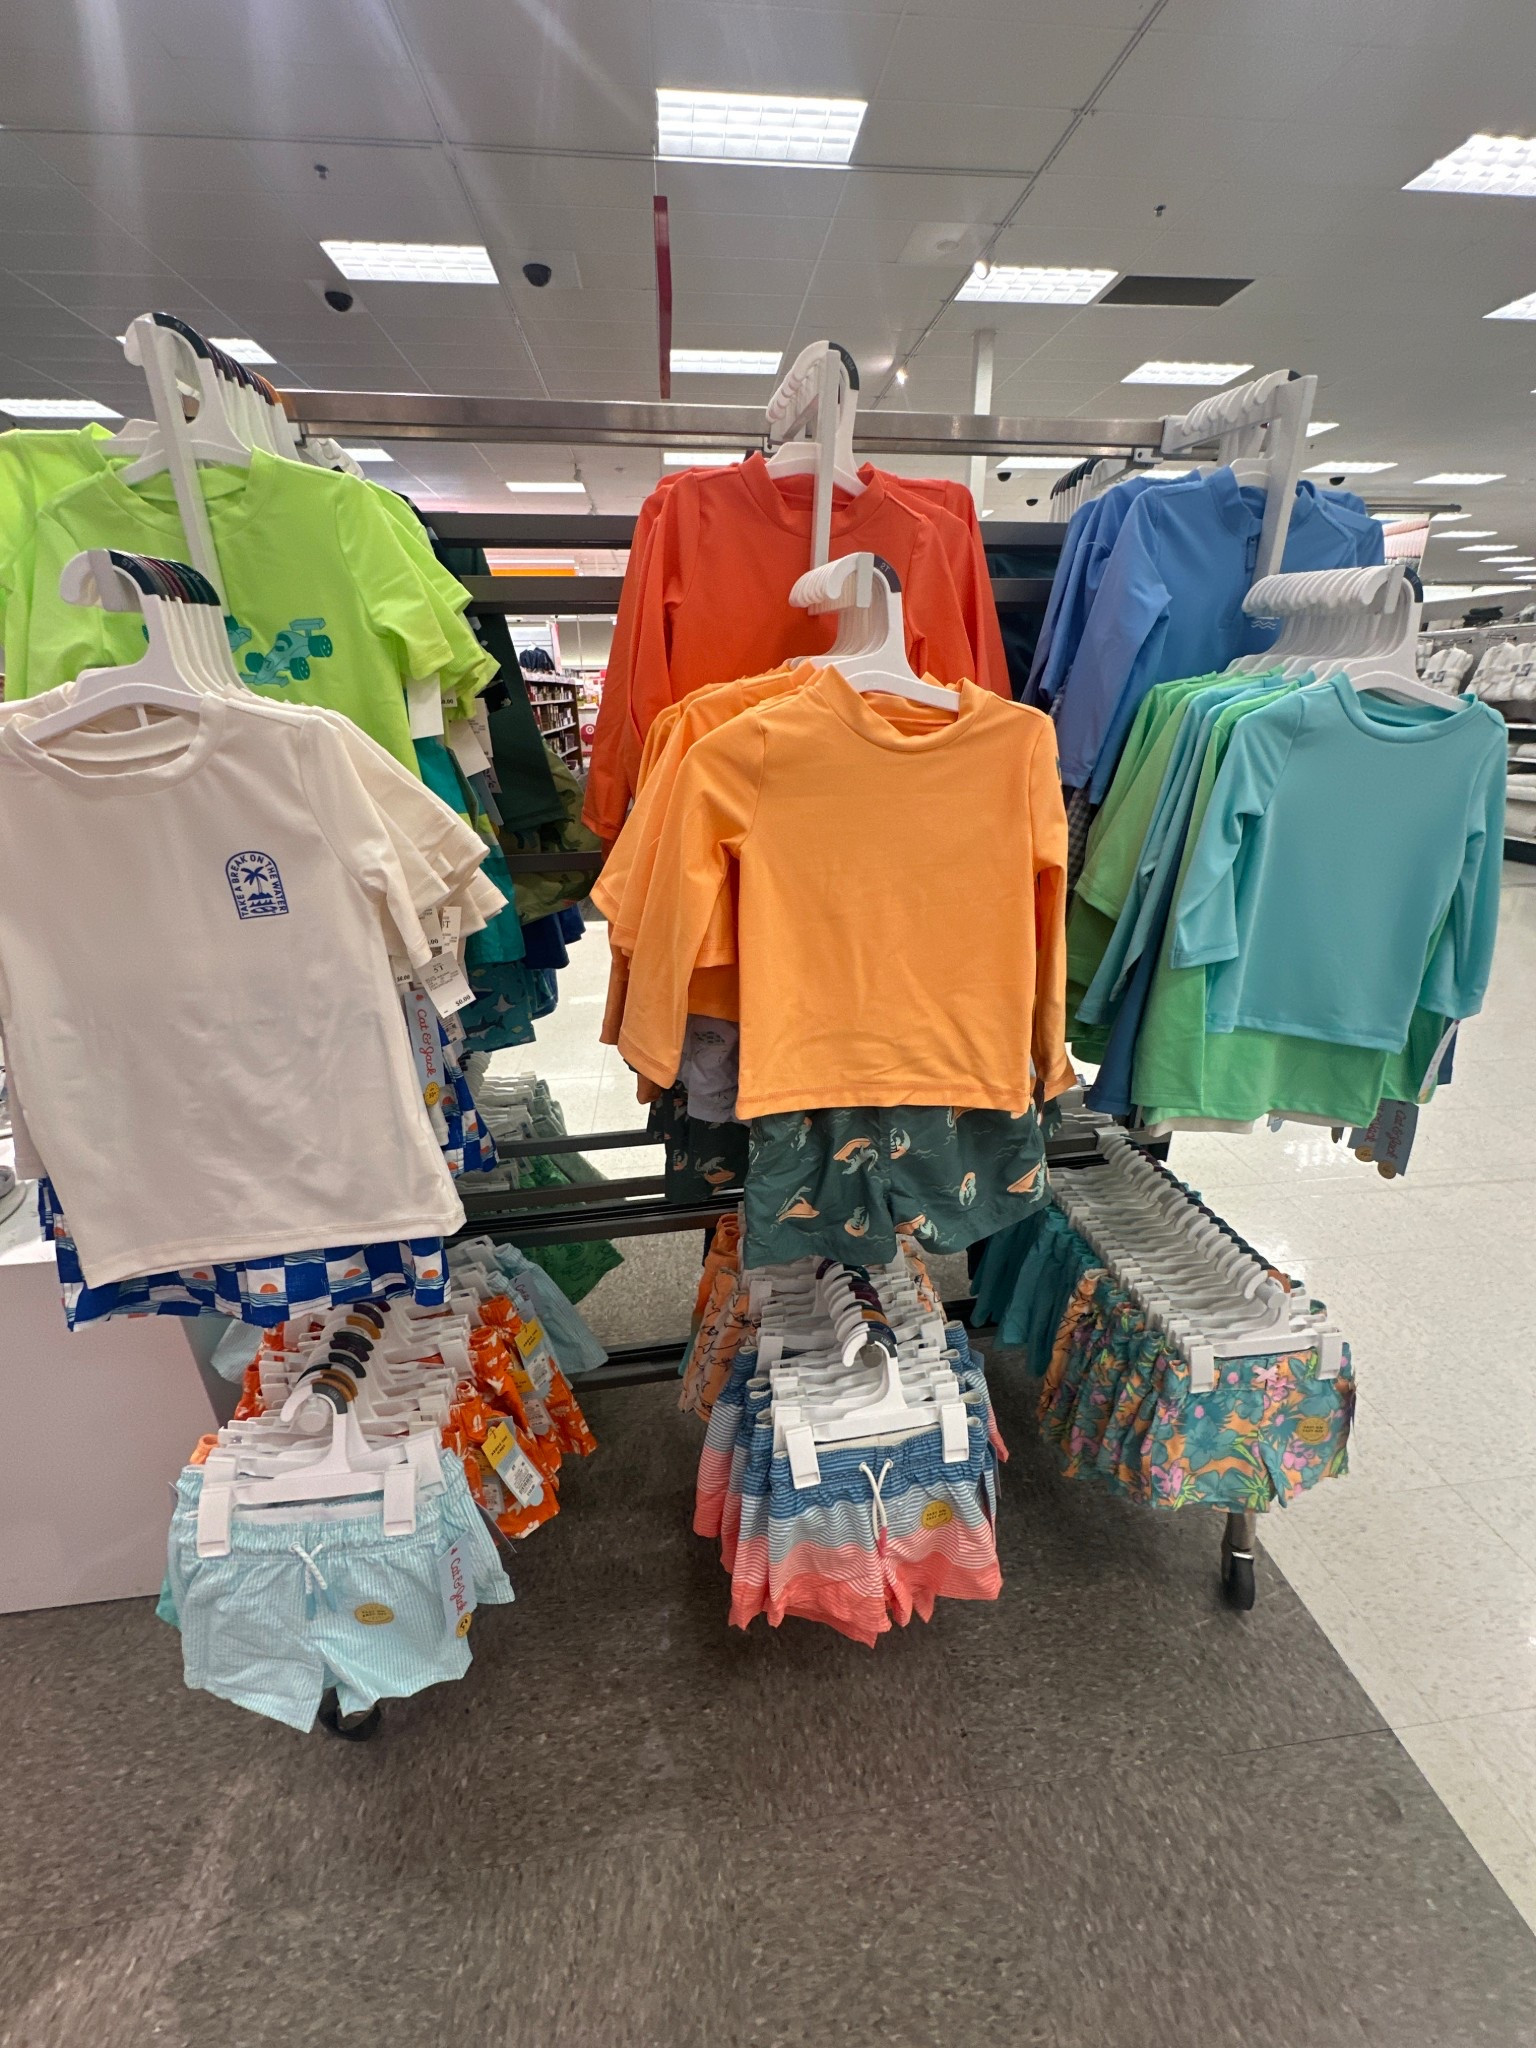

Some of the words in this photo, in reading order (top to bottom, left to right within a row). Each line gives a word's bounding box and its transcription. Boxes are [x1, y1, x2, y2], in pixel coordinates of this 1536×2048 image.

[230, 855, 248, 884] BREAK
[249, 854, 265, 864] ON
[264, 861, 279, 880] THE
[234, 885, 243, 893] A
[271, 880, 287, 912] WATER
[236, 894, 250, 917] TAKE
[417, 1008, 429, 1032] Cat
[422, 1032, 432, 1046] &
[419, 1046, 437, 1079] Jack
